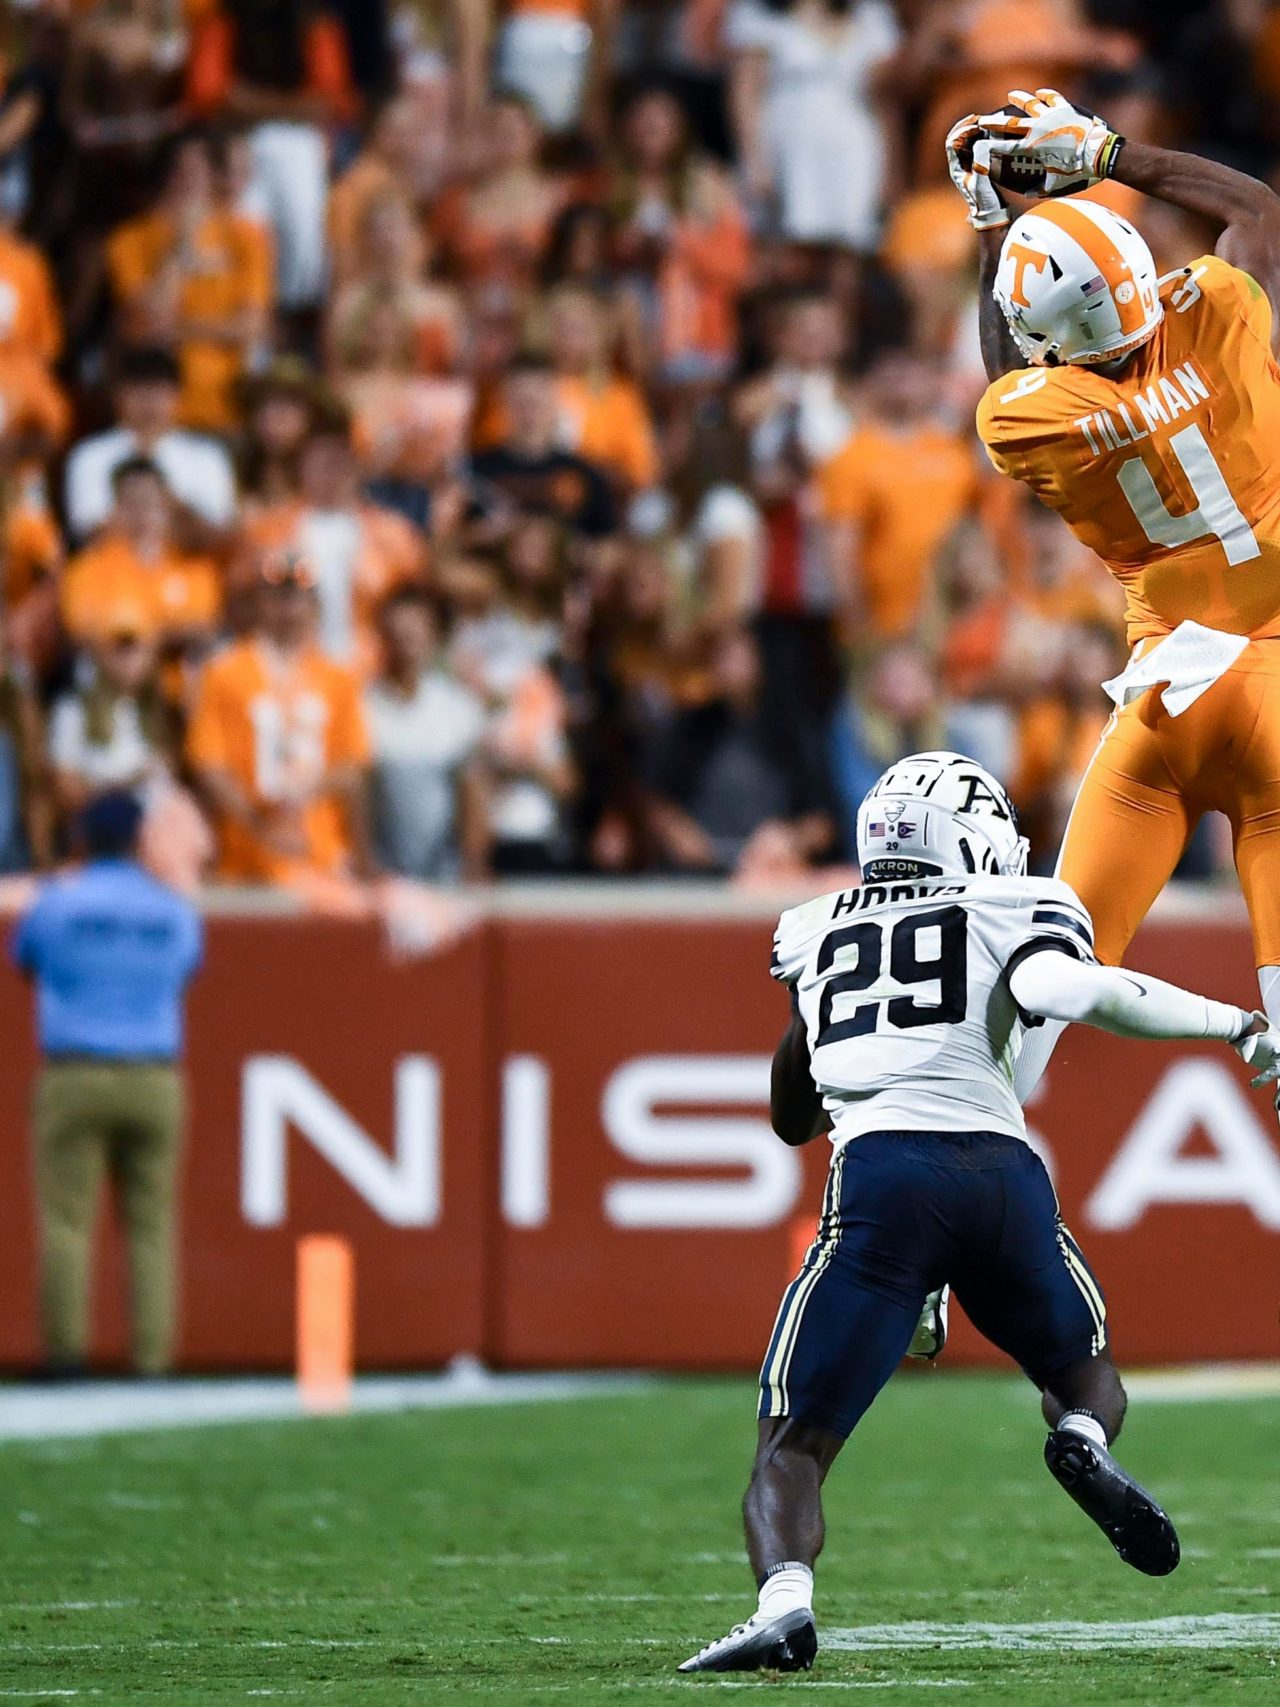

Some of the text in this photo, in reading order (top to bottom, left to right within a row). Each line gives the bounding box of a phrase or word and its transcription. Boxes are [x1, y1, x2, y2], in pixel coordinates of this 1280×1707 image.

[1006, 243, 1048, 308] T
[1074, 361, 1210, 456] TILLMAN
[1116, 422, 1262, 567] 4
[871, 861, 918, 873] AKRON
[886, 842, 899, 851] 29
[814, 904, 968, 1048] 29
